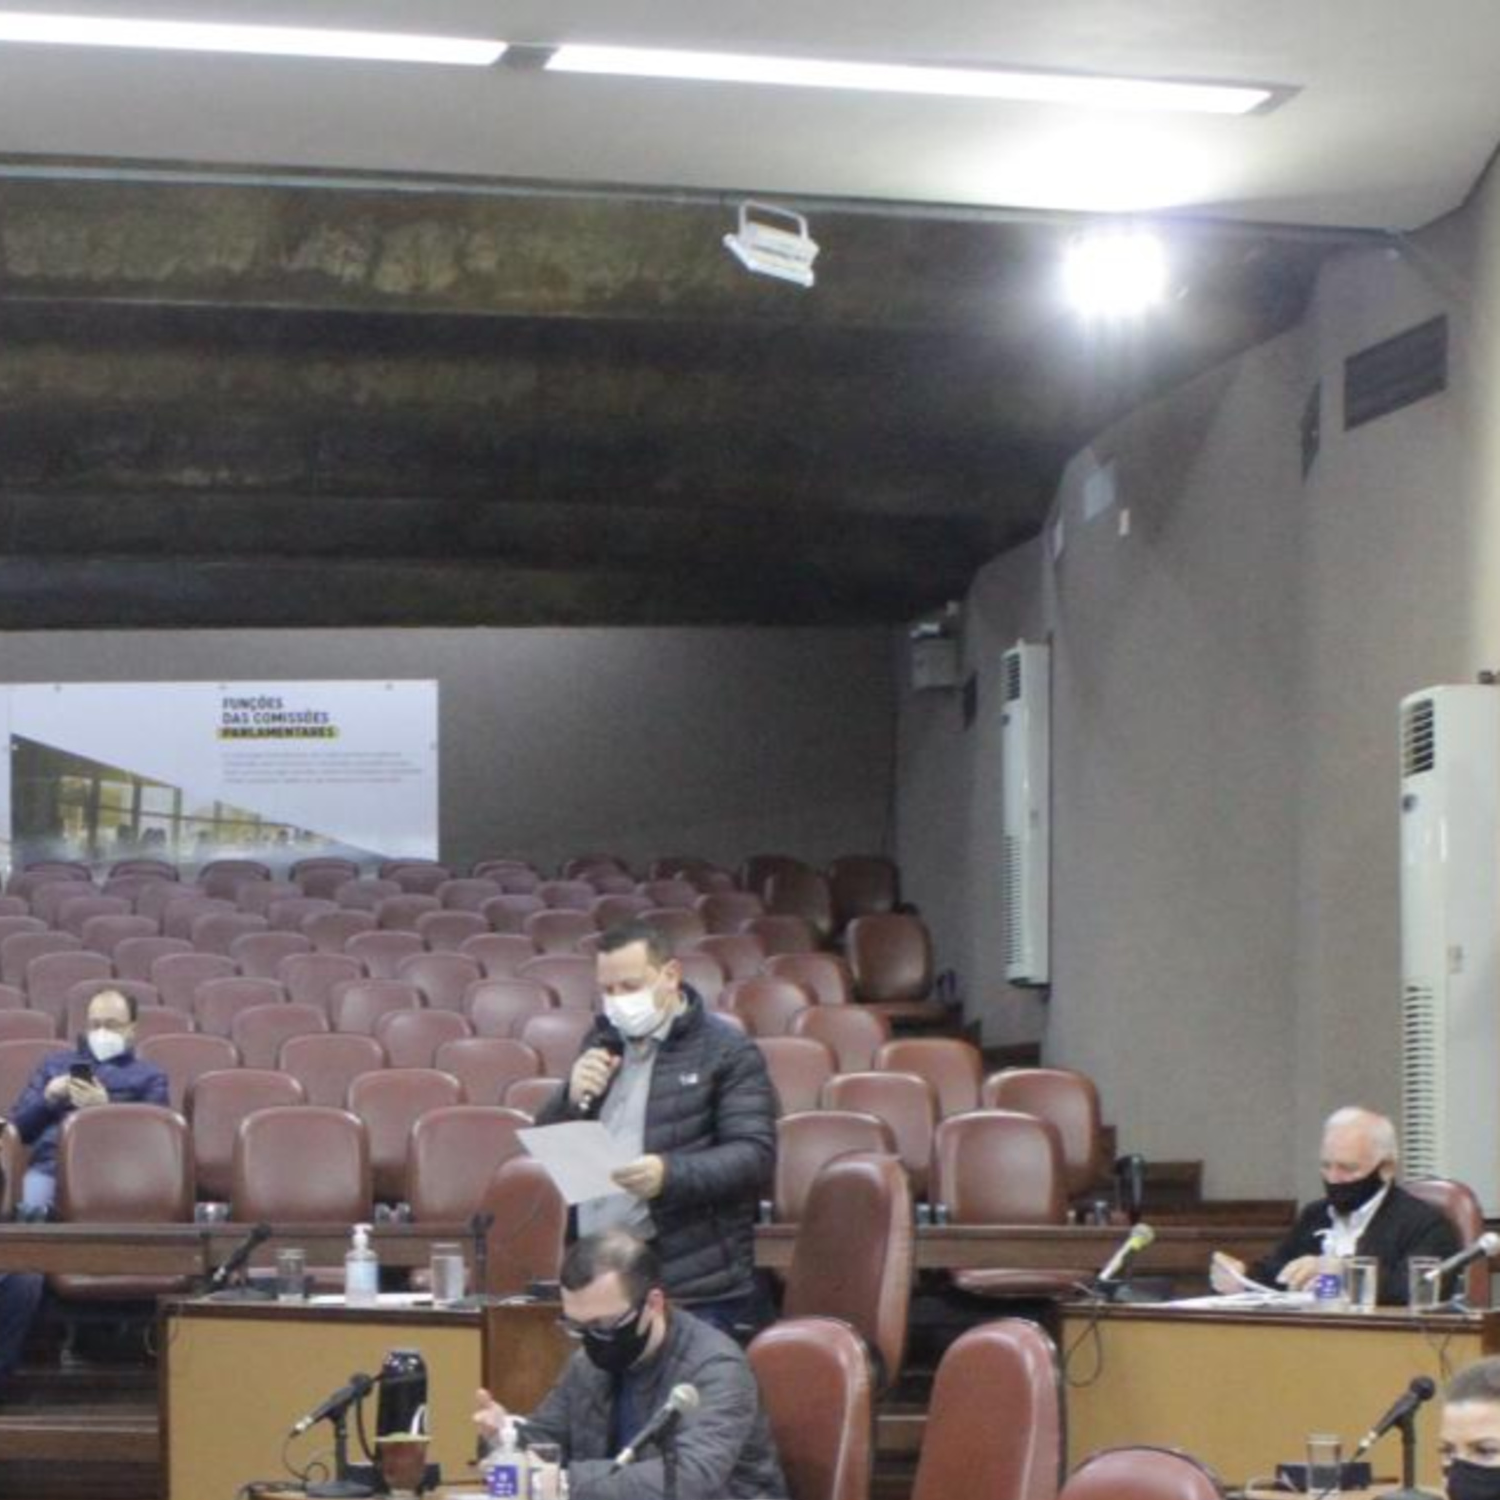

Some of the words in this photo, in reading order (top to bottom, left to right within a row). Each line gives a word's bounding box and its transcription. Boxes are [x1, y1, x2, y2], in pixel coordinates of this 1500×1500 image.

[222, 696, 282, 711] FUNÇÕES
[222, 713, 249, 724] DAS
[253, 709, 329, 724] COMISSÕES
[221, 726, 336, 739] PARLAMENTARES
